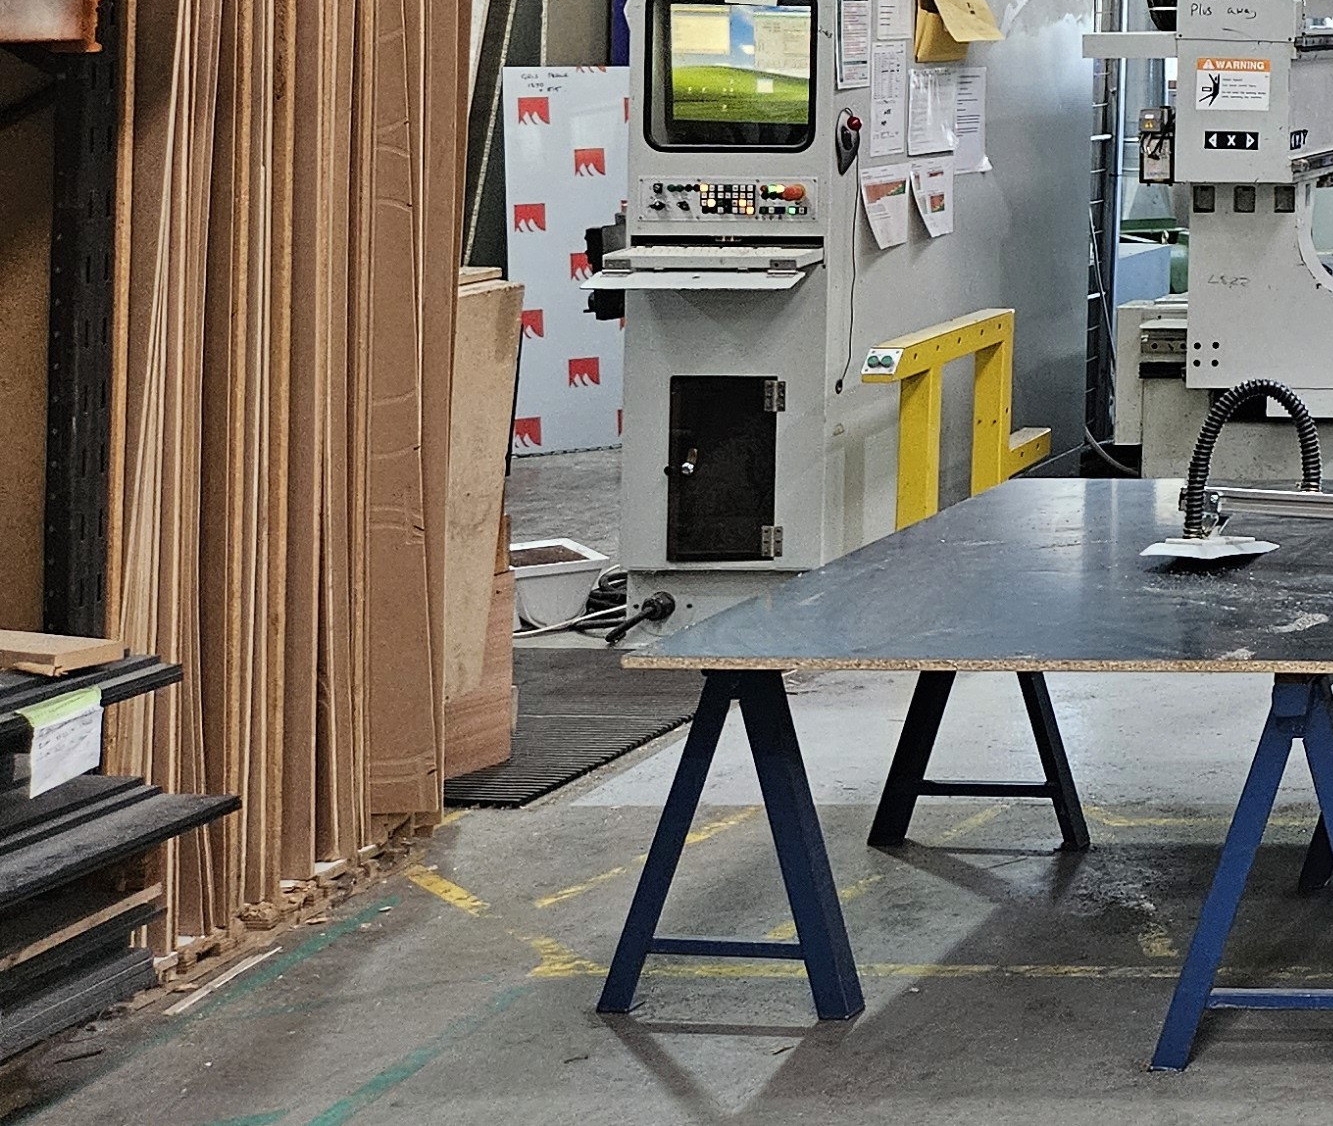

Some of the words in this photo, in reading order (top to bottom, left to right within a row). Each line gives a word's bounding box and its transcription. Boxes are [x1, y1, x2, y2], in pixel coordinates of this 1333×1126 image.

[1190, 3, 1213, 16] Plus
[1215, 60, 1265, 70] WARNING
[1227, 134, 1237, 147] X
